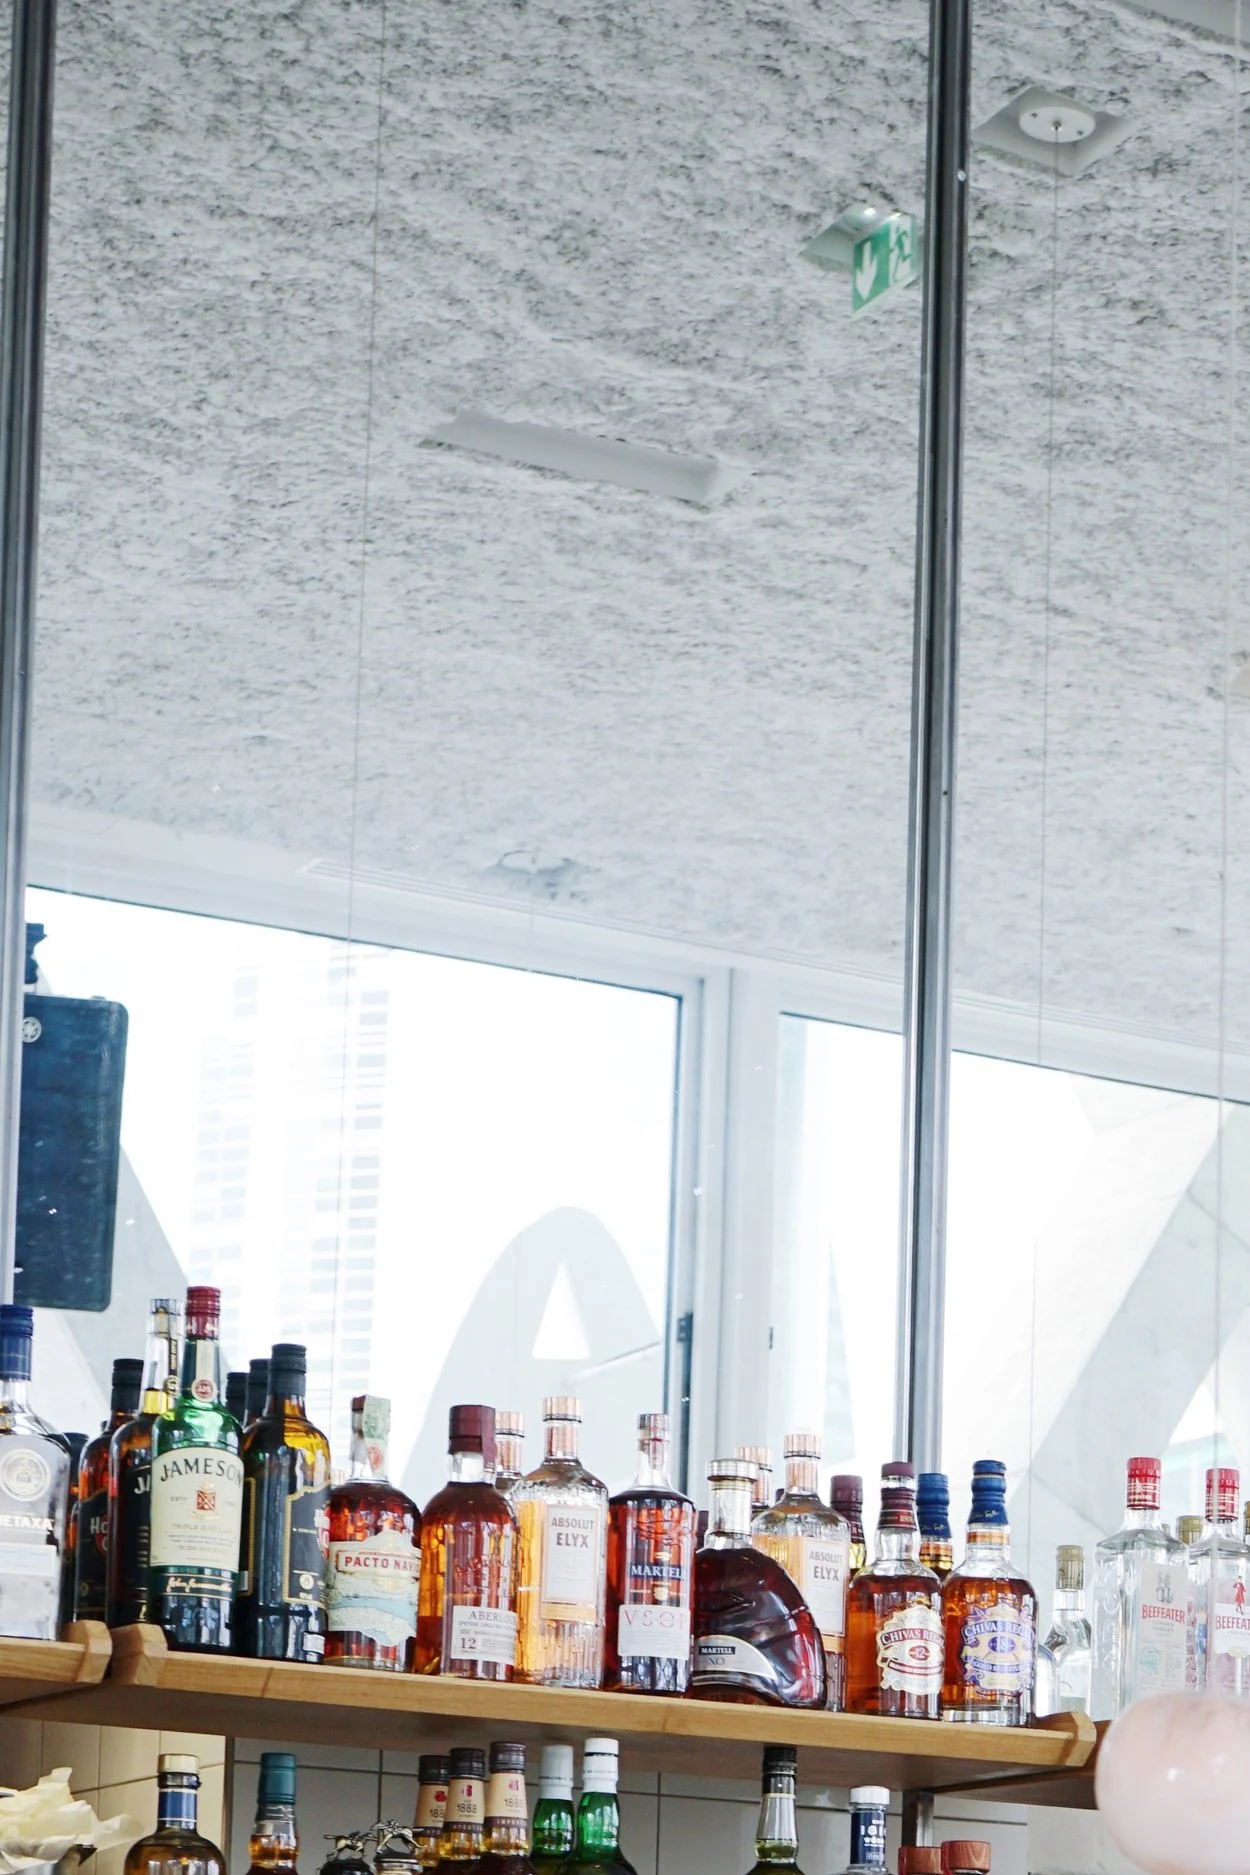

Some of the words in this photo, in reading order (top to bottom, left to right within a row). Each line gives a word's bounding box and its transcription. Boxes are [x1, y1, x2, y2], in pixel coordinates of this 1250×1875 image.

[160, 1457, 243, 1488] JAMESON
[0, 1515, 54, 1531] ETAXA
[551, 1517, 595, 1530] ABSOLUT
[556, 1532, 589, 1548] ELYX
[345, 1556, 388, 1569] PACTO
[808, 1551, 844, 1564] ABSOLUT
[813, 1566, 840, 1581] ELYX
[1142, 1603, 1186, 1625] BEEFEATER
[964, 1621, 1004, 1637] CHIVAS
[460, 1637, 476, 1650] 12
[882, 1629, 921, 1645] CHIVAS
[701, 1647, 734, 1655] MARTELL
[916, 1648, 926, 1659] 12
